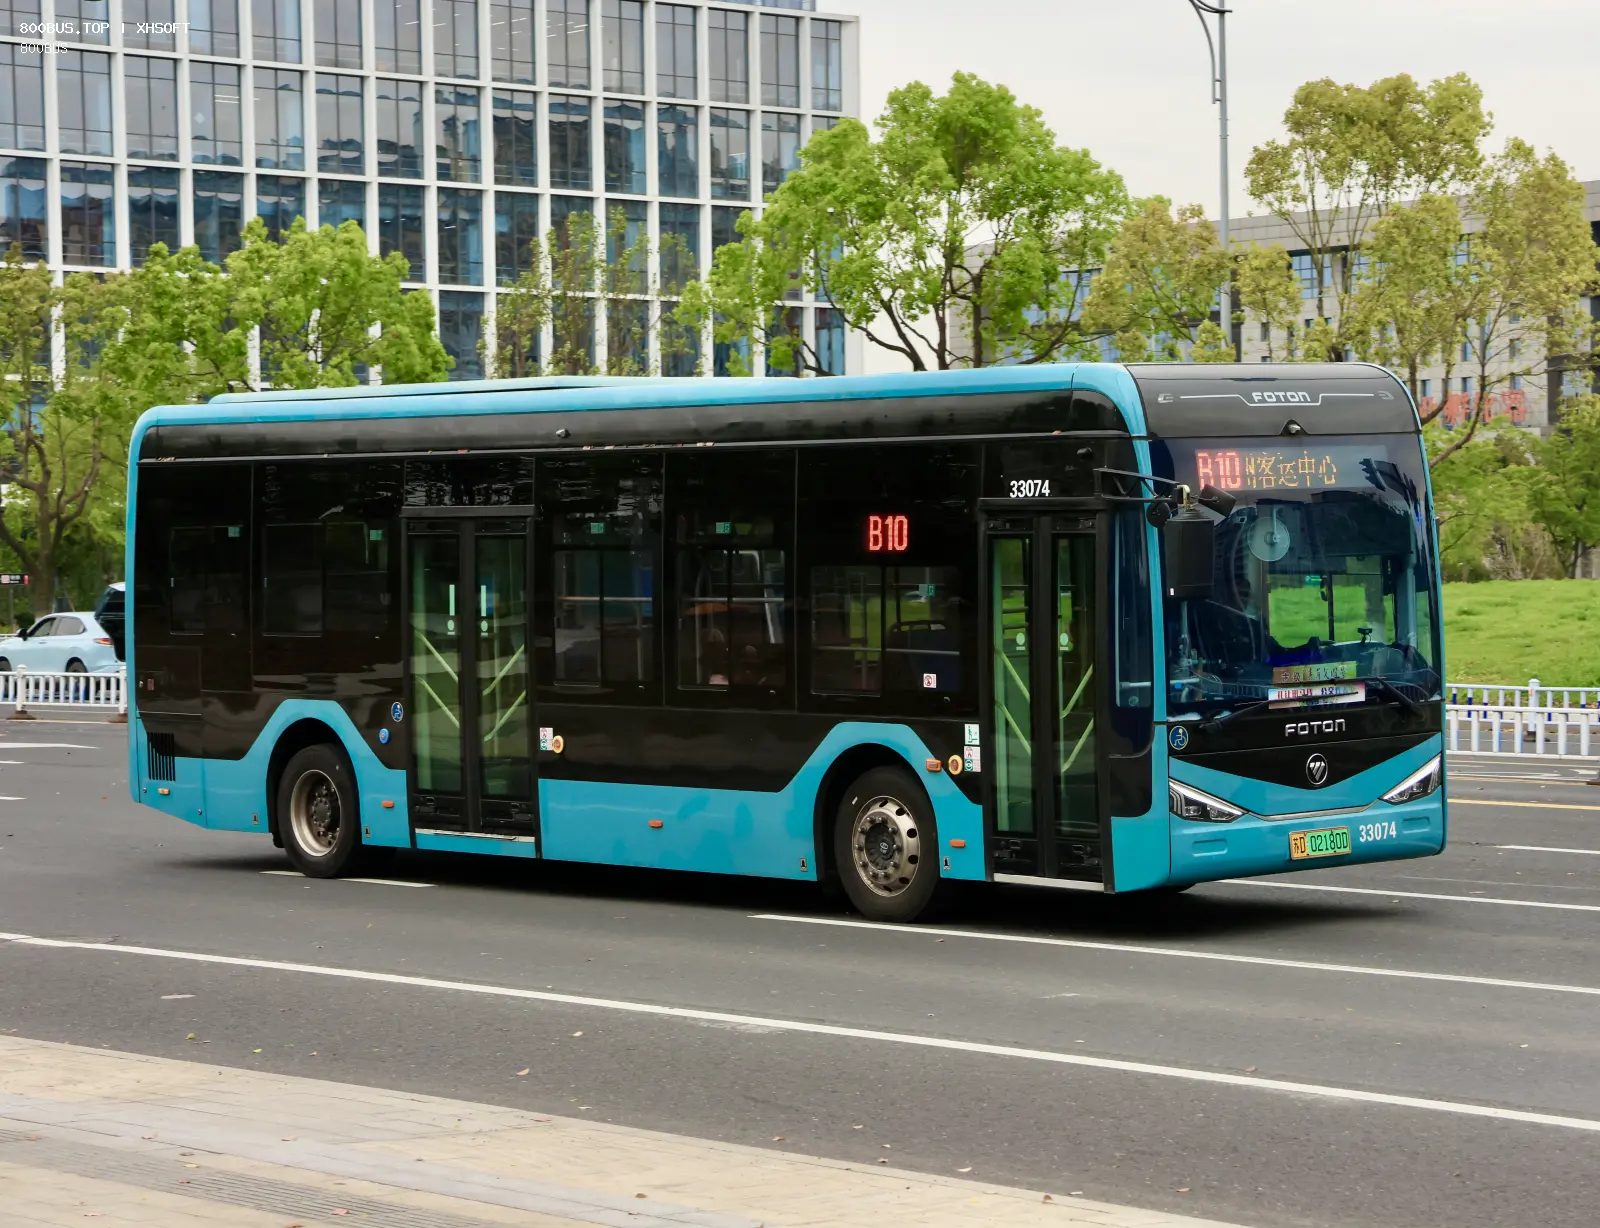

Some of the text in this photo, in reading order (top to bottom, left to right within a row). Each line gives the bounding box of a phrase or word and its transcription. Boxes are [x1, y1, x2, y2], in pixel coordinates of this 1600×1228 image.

[1251, 391, 1311, 403] FOTON
[1009, 479, 1051, 498] 33074
[868, 515, 908, 551] B10
[1285, 718, 1346, 737] FOTON
[1359, 821, 1397, 842] 33074
